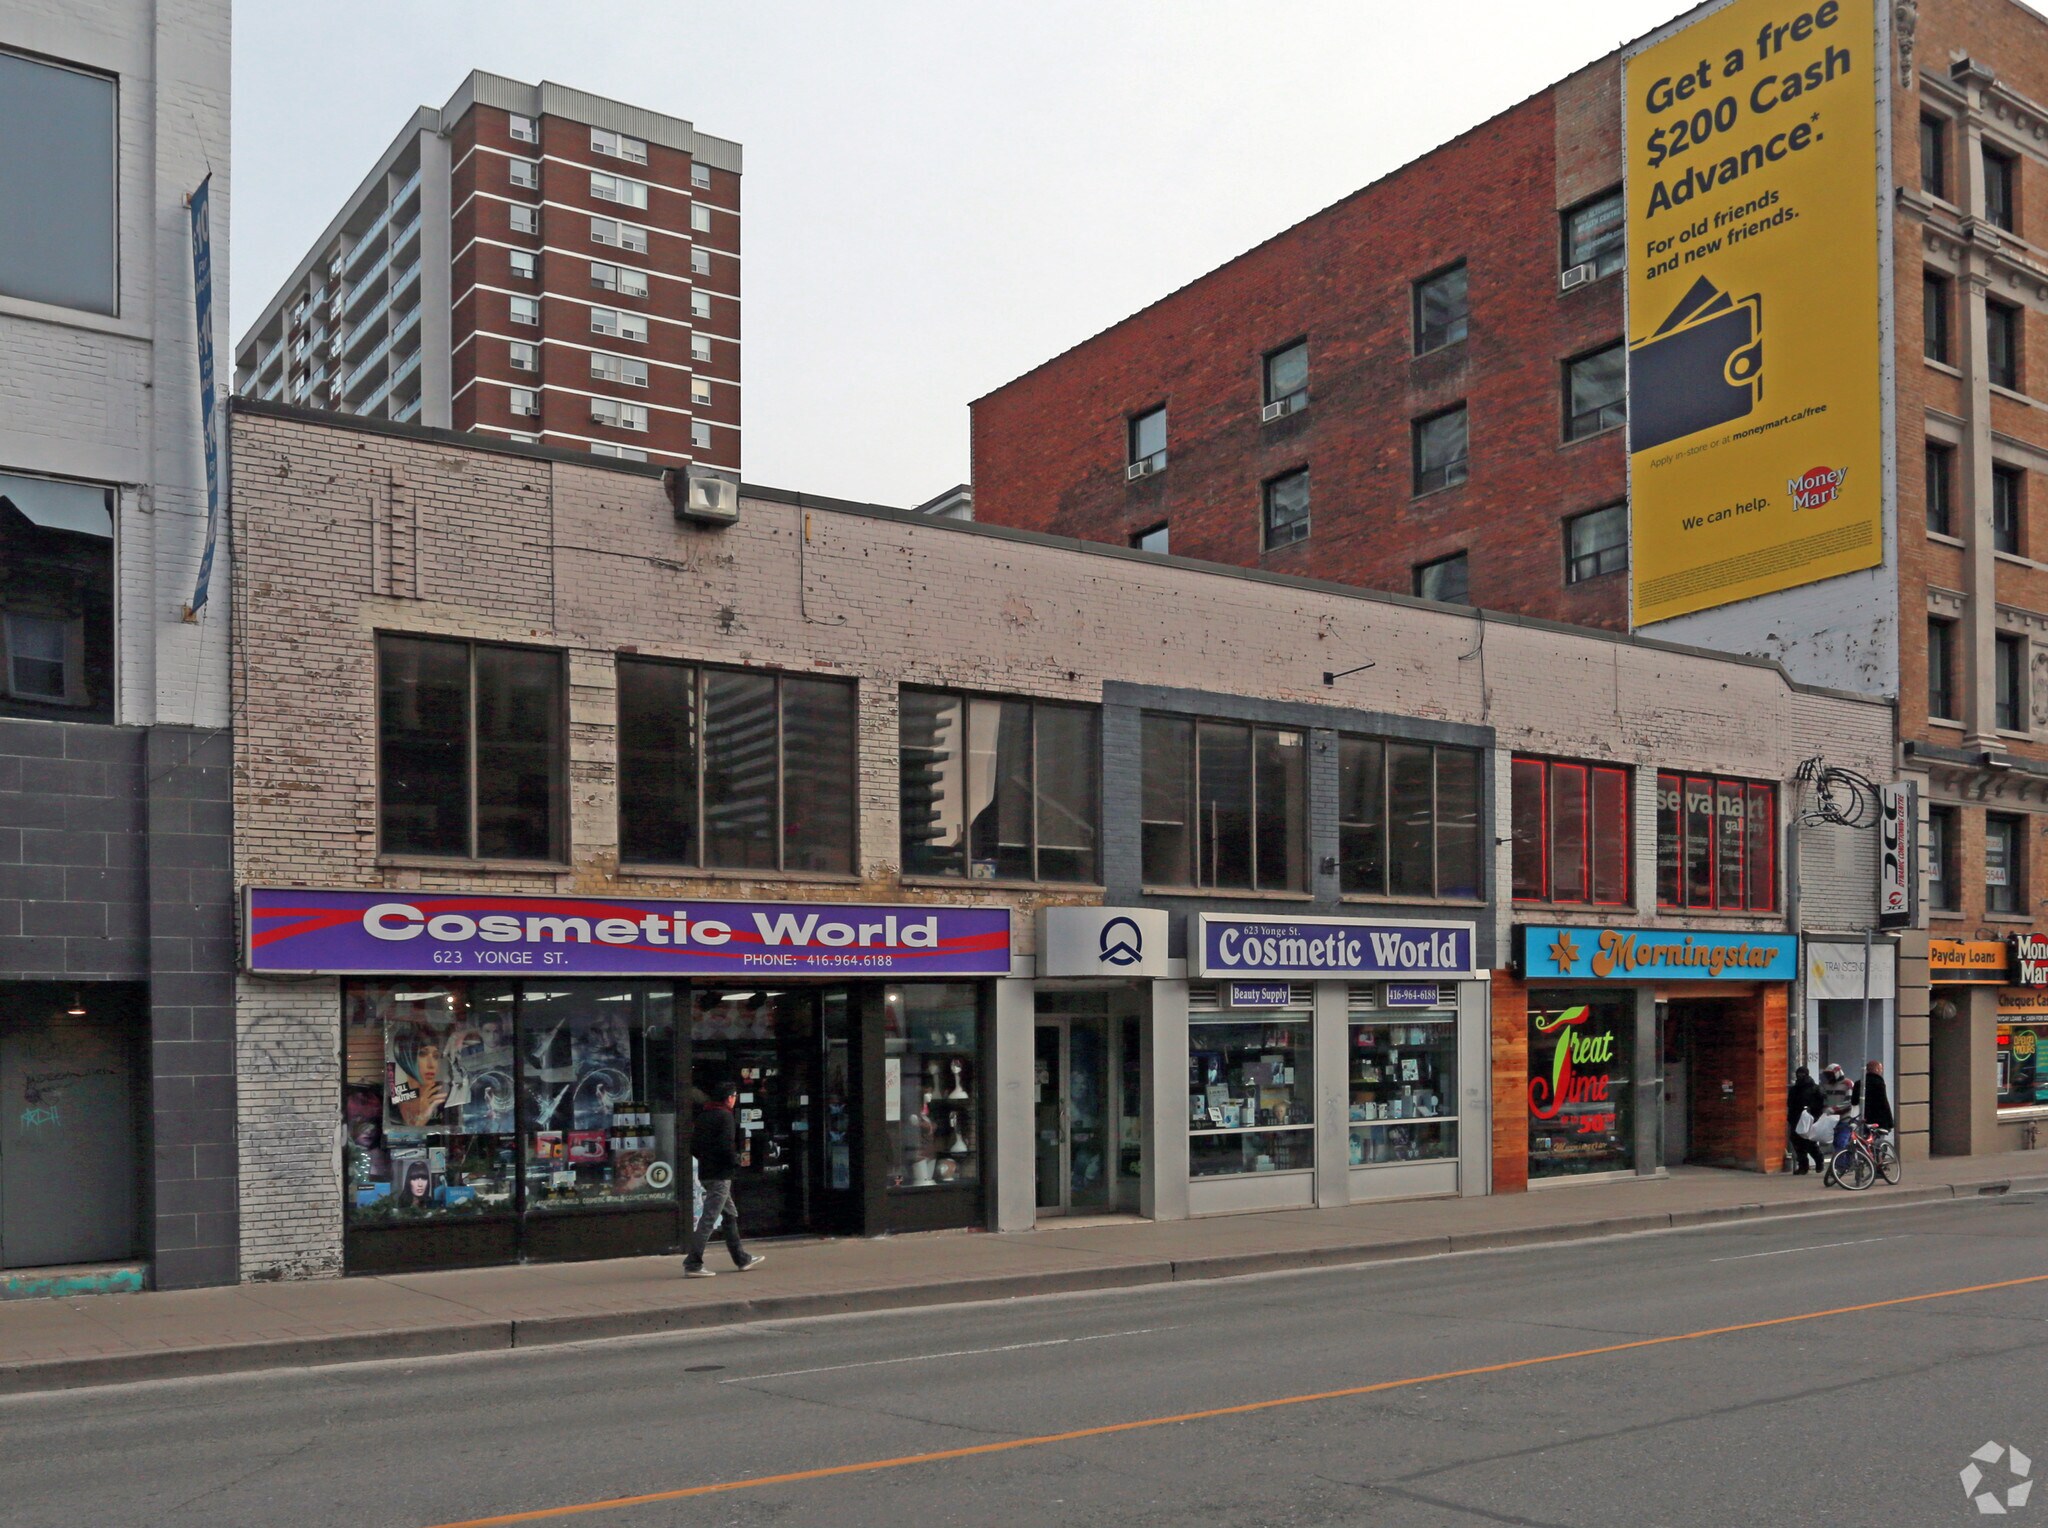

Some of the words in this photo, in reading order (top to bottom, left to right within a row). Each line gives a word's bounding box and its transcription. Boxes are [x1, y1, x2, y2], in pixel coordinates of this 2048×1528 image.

[1646, 59, 1711, 114] Get
[1723, 48, 1744, 77] a
[1757, 0, 1839, 61] free
[1647, 96, 1737, 169] $200
[1750, 45, 1850, 114] Cash
[1647, 236, 1675, 258] For
[1679, 217, 1708, 243] old
[1714, 190, 1779, 229] friends
[1646, 252, 1679, 280] and
[1684, 237, 1722, 264] new
[1727, 207, 1799, 245] friends.
[1650, 455, 1673, 469] Apply
[1675, 443, 1708, 460] in-store
[1710, 438, 1720, 448] or
[1722, 435, 1731, 444] at
[1732, 404, 1827, 441] moneymart.ca/free
[1786, 466, 1848, 496] Money
[1792, 486, 1839, 512] Mart
[1682, 516, 1703, 531] We
[1707, 508, 1732, 524] can
[1735, 498, 1770, 516] help.
[1897, 794, 1905, 818] CENTRE
[1897, 818, 1905, 859] CONDITIONING
[1897, 859, 1905, 888] DYNAMIC
[362, 903, 732, 947] Cosmetic
[752, 911, 938, 948] World
[1243, 926, 1259, 935] 623
[1260, 926, 1287, 938] Yonge
[1288, 926, 1301, 936] St.
[433, 951, 462, 964] 623
[474, 951, 533, 965] YONGE
[543, 951, 569, 965] ST.
[743, 954, 798, 967] PHONE:
[806, 955, 893, 967] 416.964.6188
[1219, 928, 1362, 967] Cosmetic
[1369, 930, 1458, 968] World
[1591, 929, 1779, 977] Morningstar
[1931, 948, 1966, 965] Payday
[1969, 949, 1995, 963] Loans
[2017, 936, 2048, 960] Mon
[1234, 988, 1260, 1002] Beauty
[1262, 988, 1288, 1004] Supply
[1389, 988, 1437, 1001] 416-964-6188
[1999, 994, 2035, 1010] Cheques
[1576, 1114, 1604, 1133] 50
